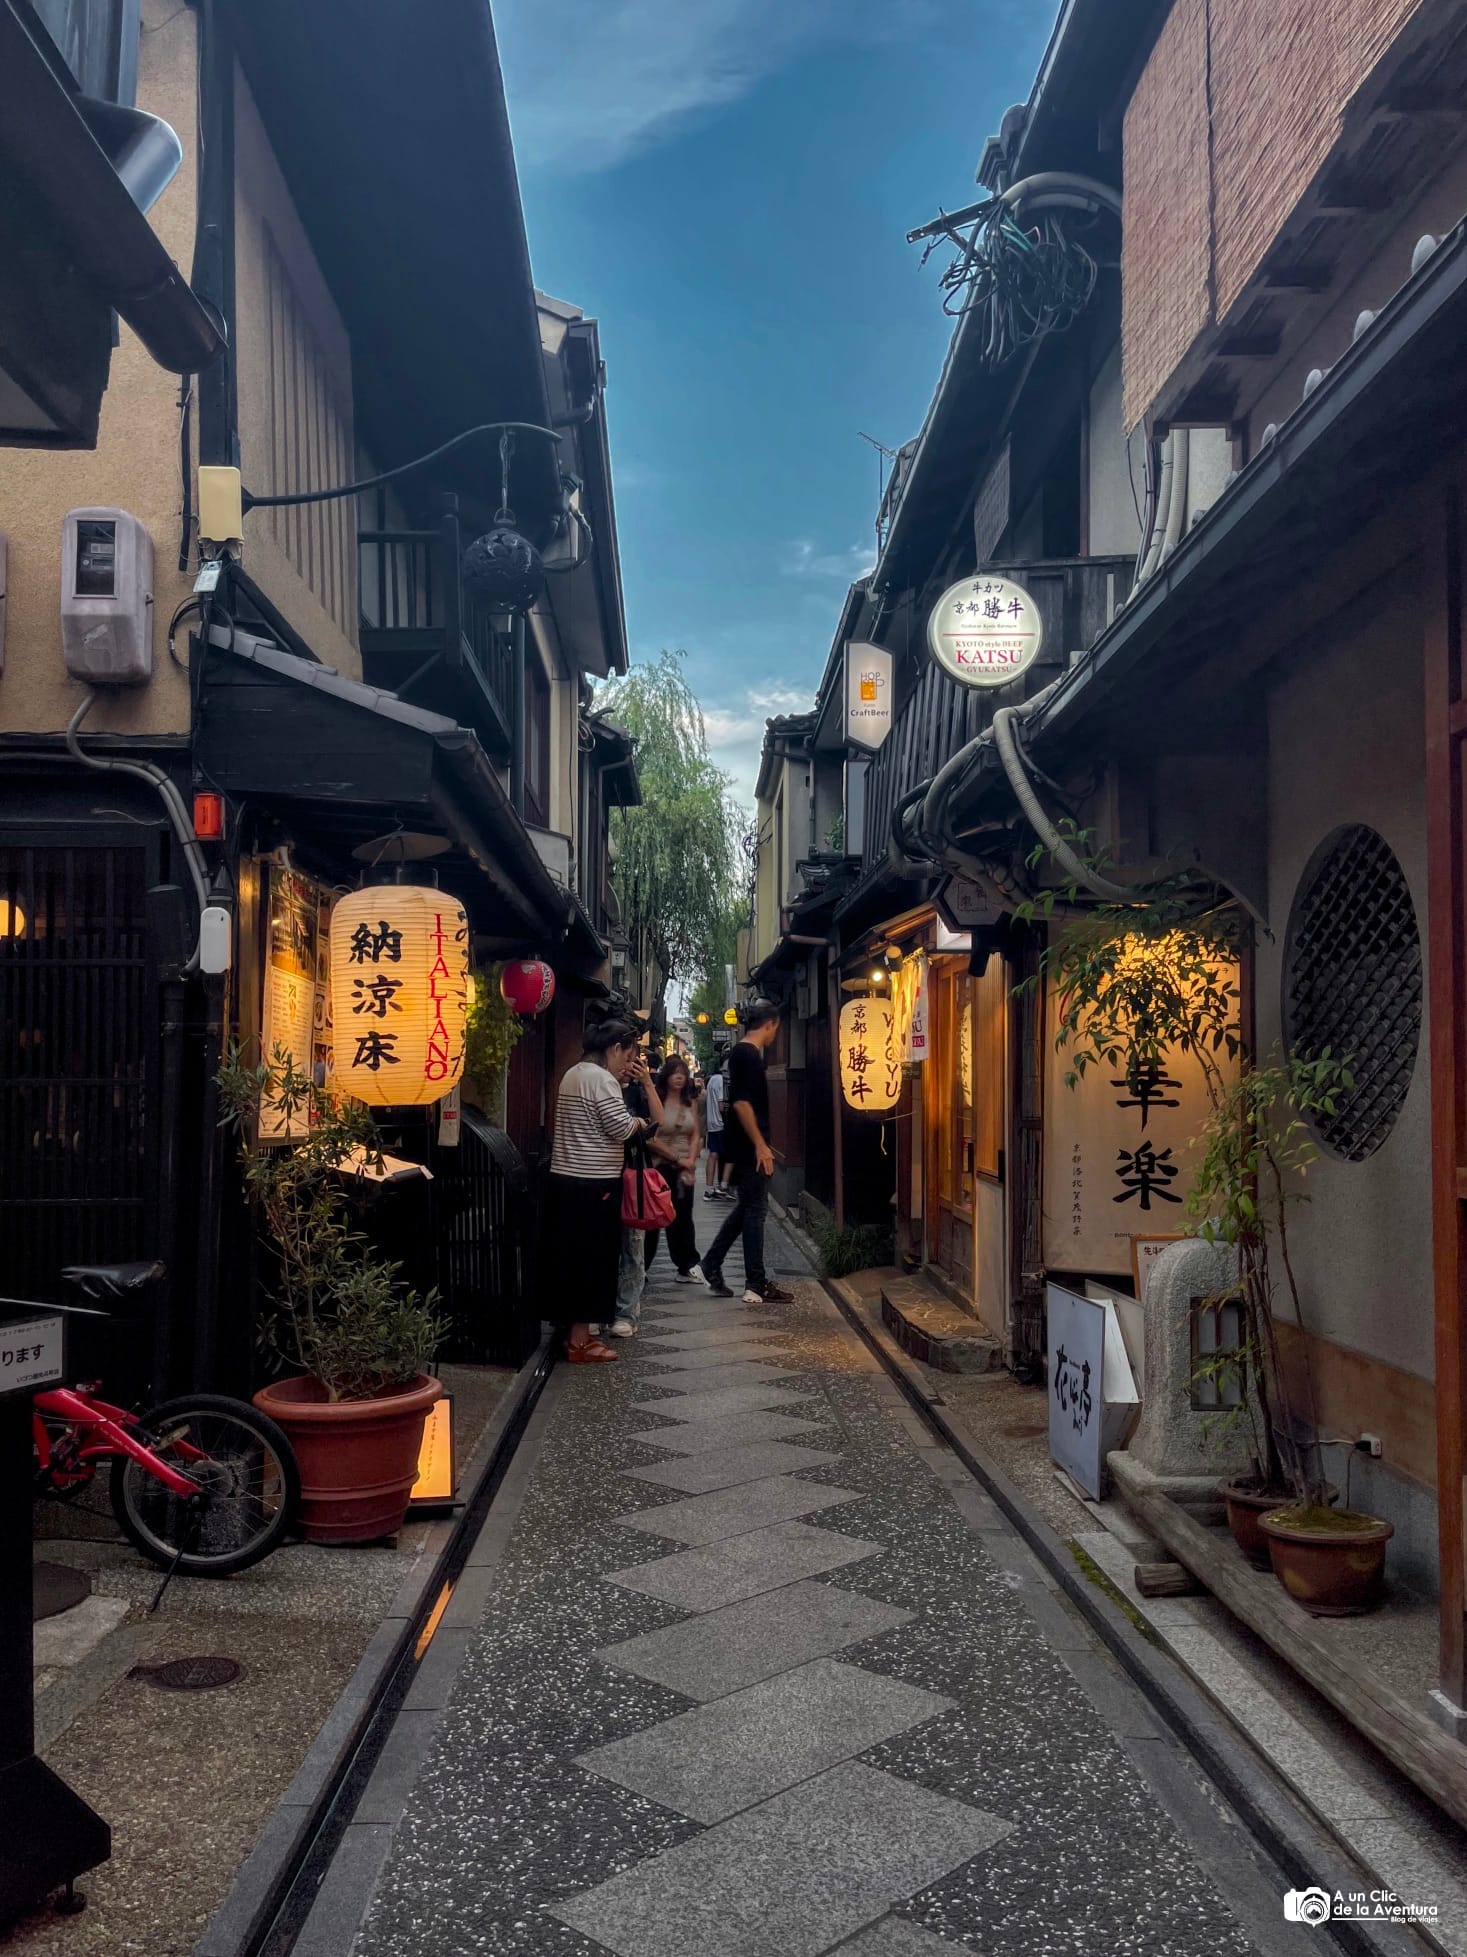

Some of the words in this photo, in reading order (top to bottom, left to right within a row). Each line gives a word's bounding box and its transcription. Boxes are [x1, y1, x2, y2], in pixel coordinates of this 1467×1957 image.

[972, 581, 1004, 594] 牛カツ
[956, 650, 1023, 664] KATSU
[861, 672, 880, 681] HOP
[348, 920, 403, 1072] 納涼床
[424, 913, 450, 1081] ITALIANO
[2, 1344, 45, 1367] ります
